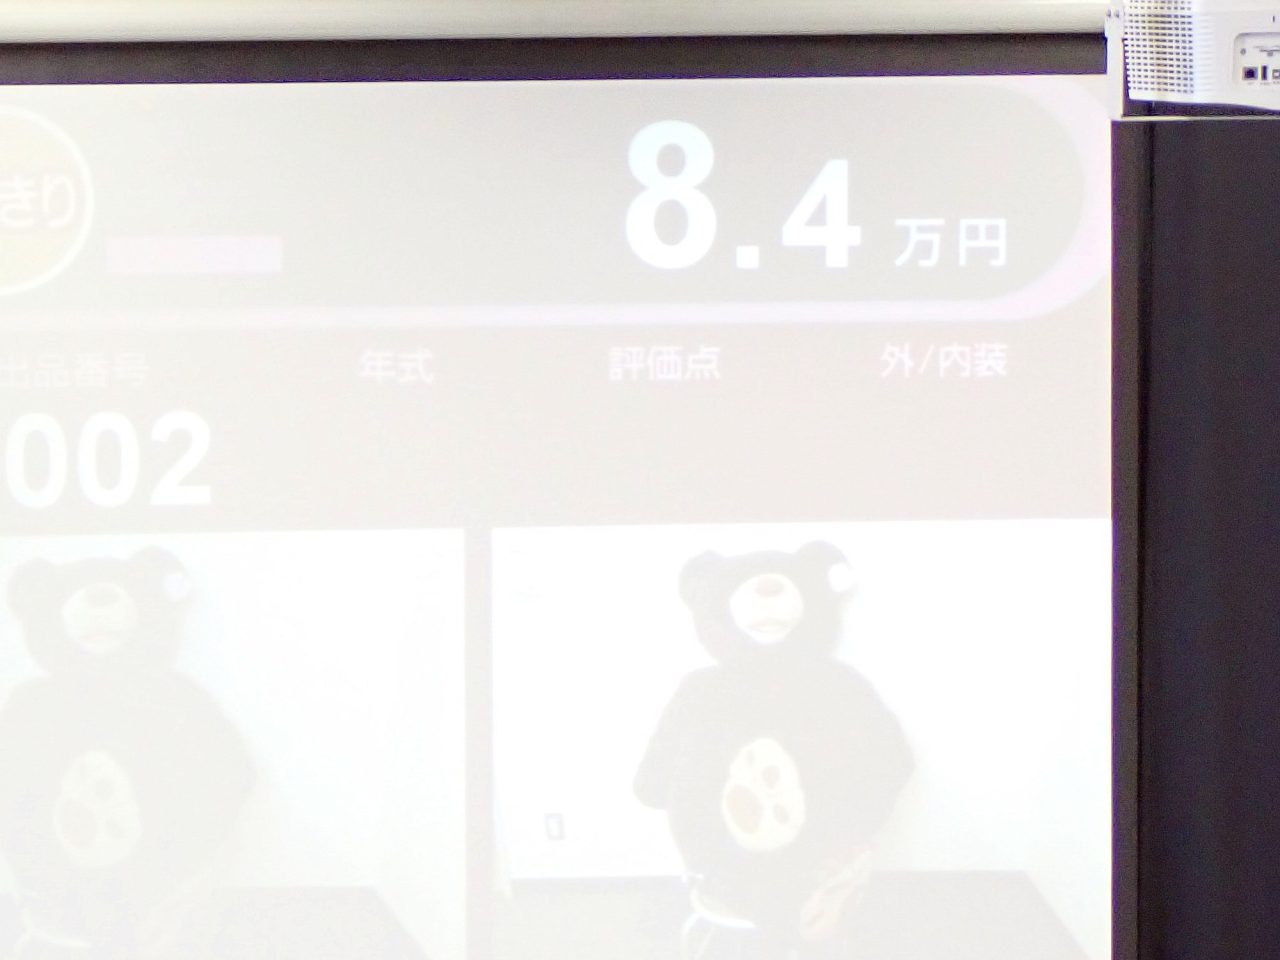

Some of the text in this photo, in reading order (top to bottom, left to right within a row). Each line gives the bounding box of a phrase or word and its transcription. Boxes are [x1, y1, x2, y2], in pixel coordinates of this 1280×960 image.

[625, 119, 1008, 269] 8.4 万円
[358, 348, 435, 384] 年式
[608, 346, 721, 381] 評価点
[879, 342, 1009, 378] 外/内装
